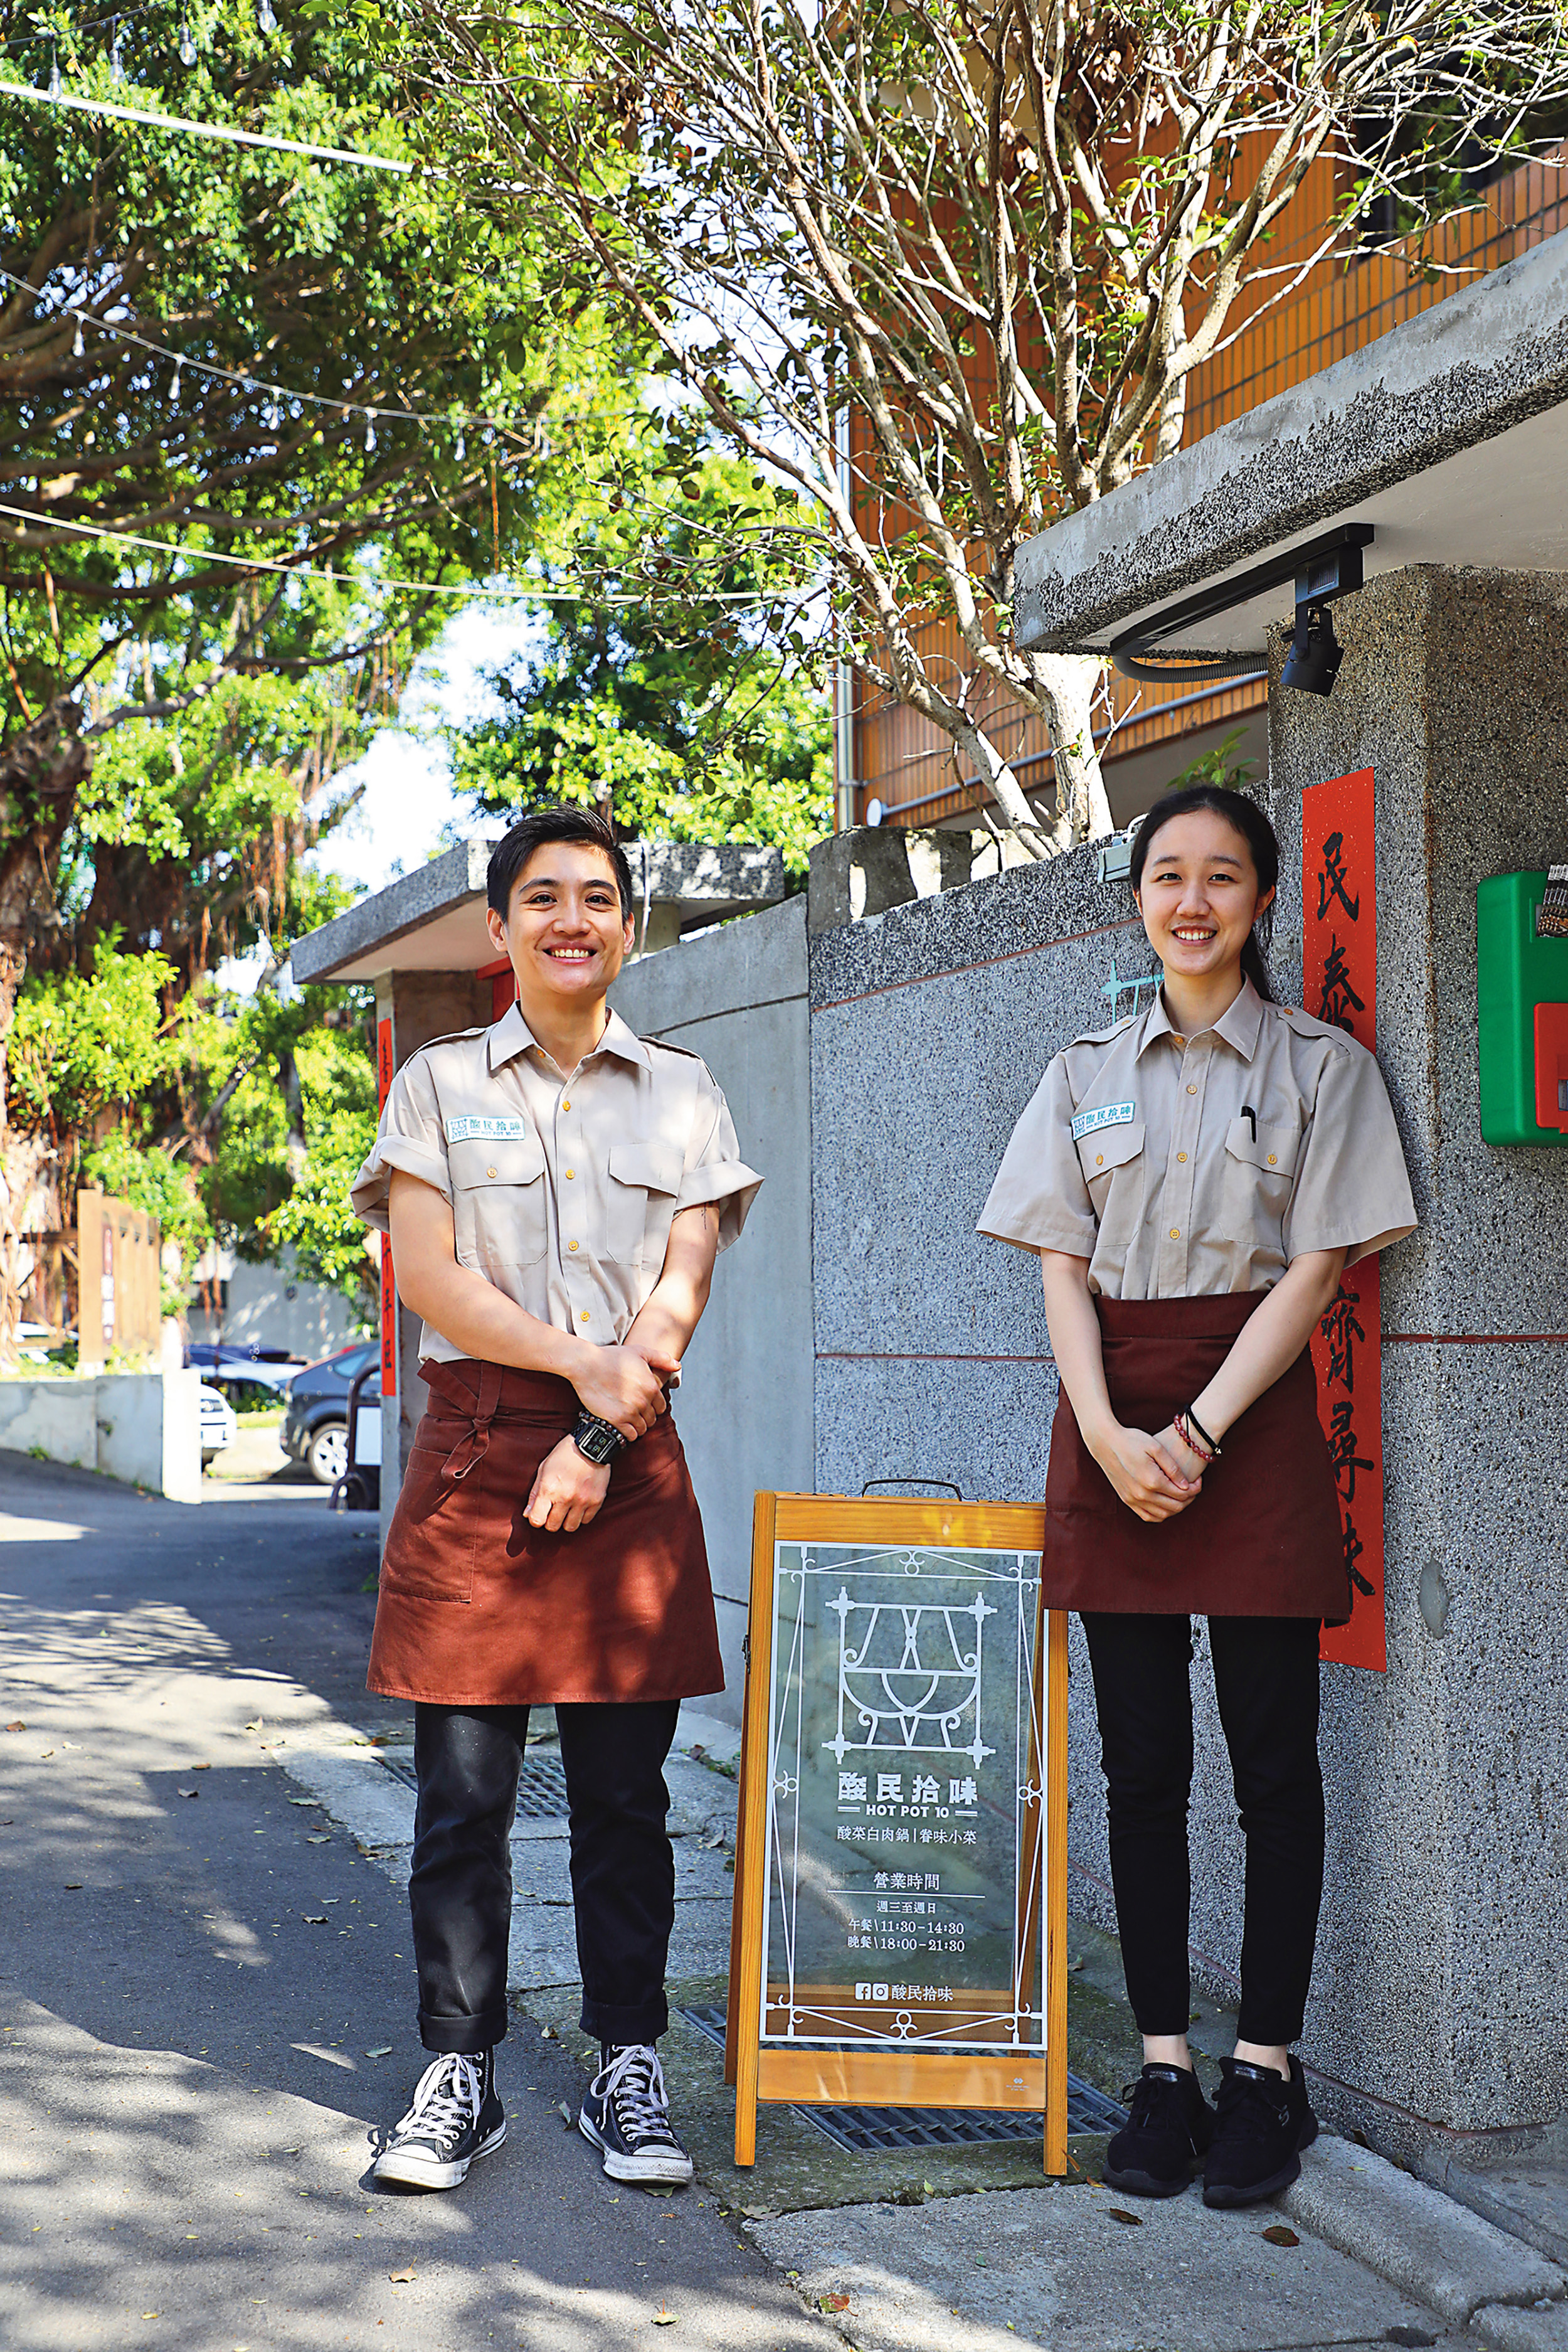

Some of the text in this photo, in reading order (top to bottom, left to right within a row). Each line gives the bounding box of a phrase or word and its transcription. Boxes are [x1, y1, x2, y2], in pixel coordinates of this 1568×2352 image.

[837, 1771, 978, 1805] 酸民拾味
[866, 1804, 950, 1819] HOT POT 10
[874, 1871, 940, 1891] 營業時間
[876, 1900, 936, 1914] 週三至週日
[891, 1984, 954, 2003] 酸民拾味
